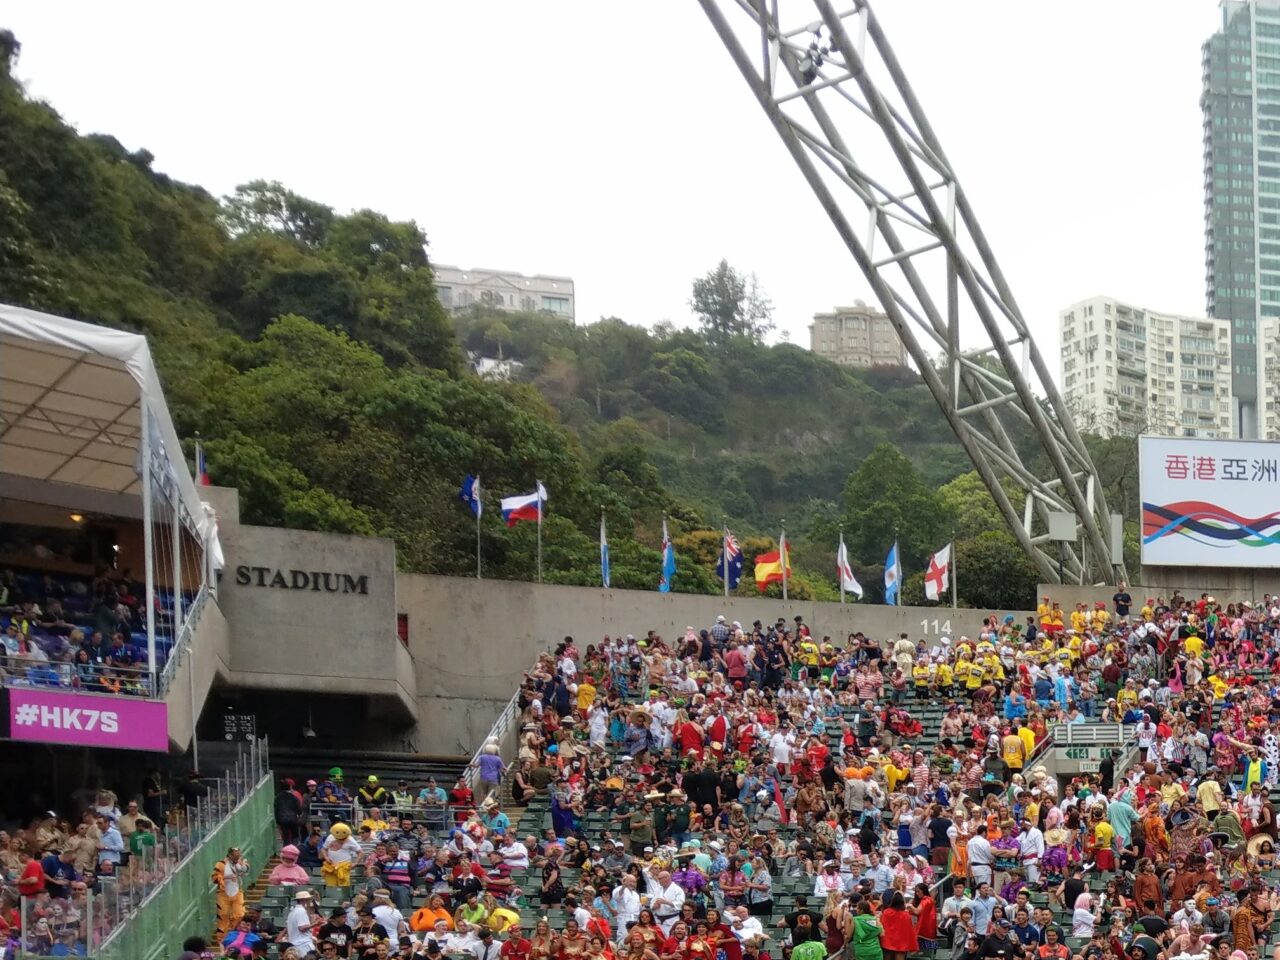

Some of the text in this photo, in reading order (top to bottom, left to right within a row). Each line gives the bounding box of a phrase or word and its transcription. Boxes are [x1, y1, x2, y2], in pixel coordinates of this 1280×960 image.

[236, 565, 369, 595] STADIUM
[920, 619, 953, 635] 114
[15, 704, 118, 733] #HK7S
[1070, 748, 1088, 759] 114
